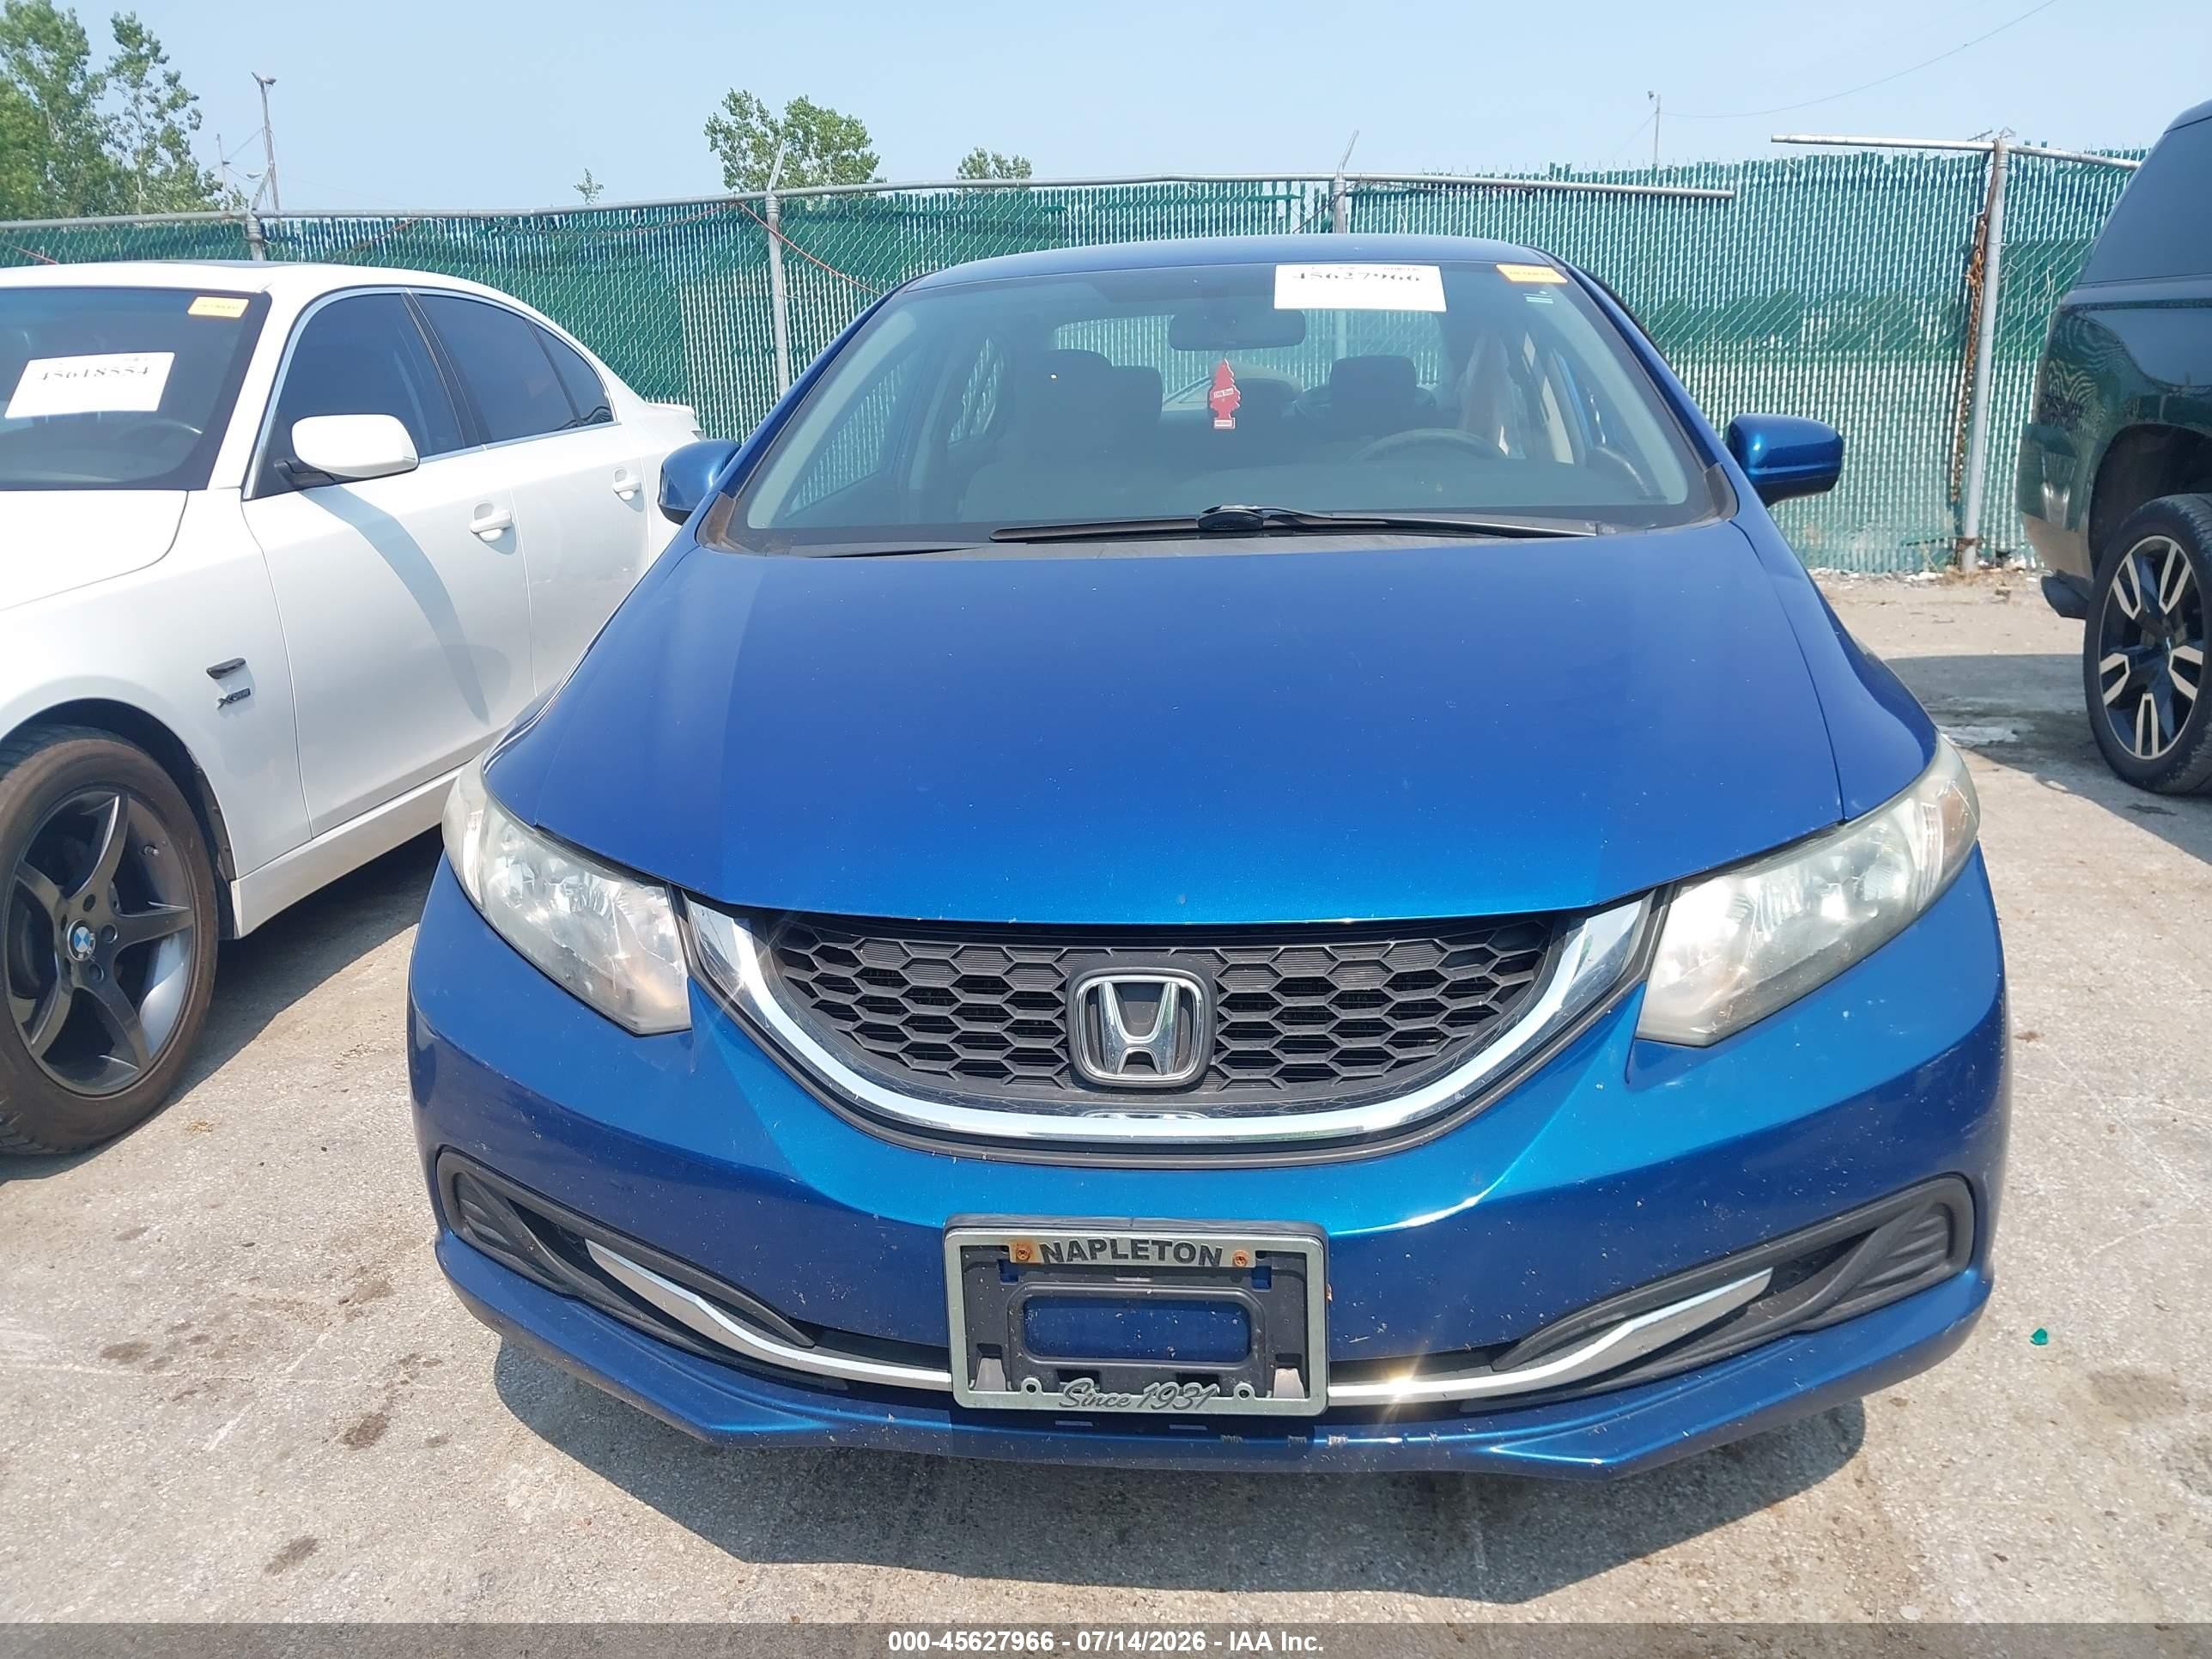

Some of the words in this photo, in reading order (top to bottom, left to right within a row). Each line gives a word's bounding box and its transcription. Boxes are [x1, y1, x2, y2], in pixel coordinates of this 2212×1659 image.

[1038, 1237, 1224, 1267] NAPLETON
[1058, 1377, 1132, 1408] Since
[1137, 1382, 1220, 1411] 1931
